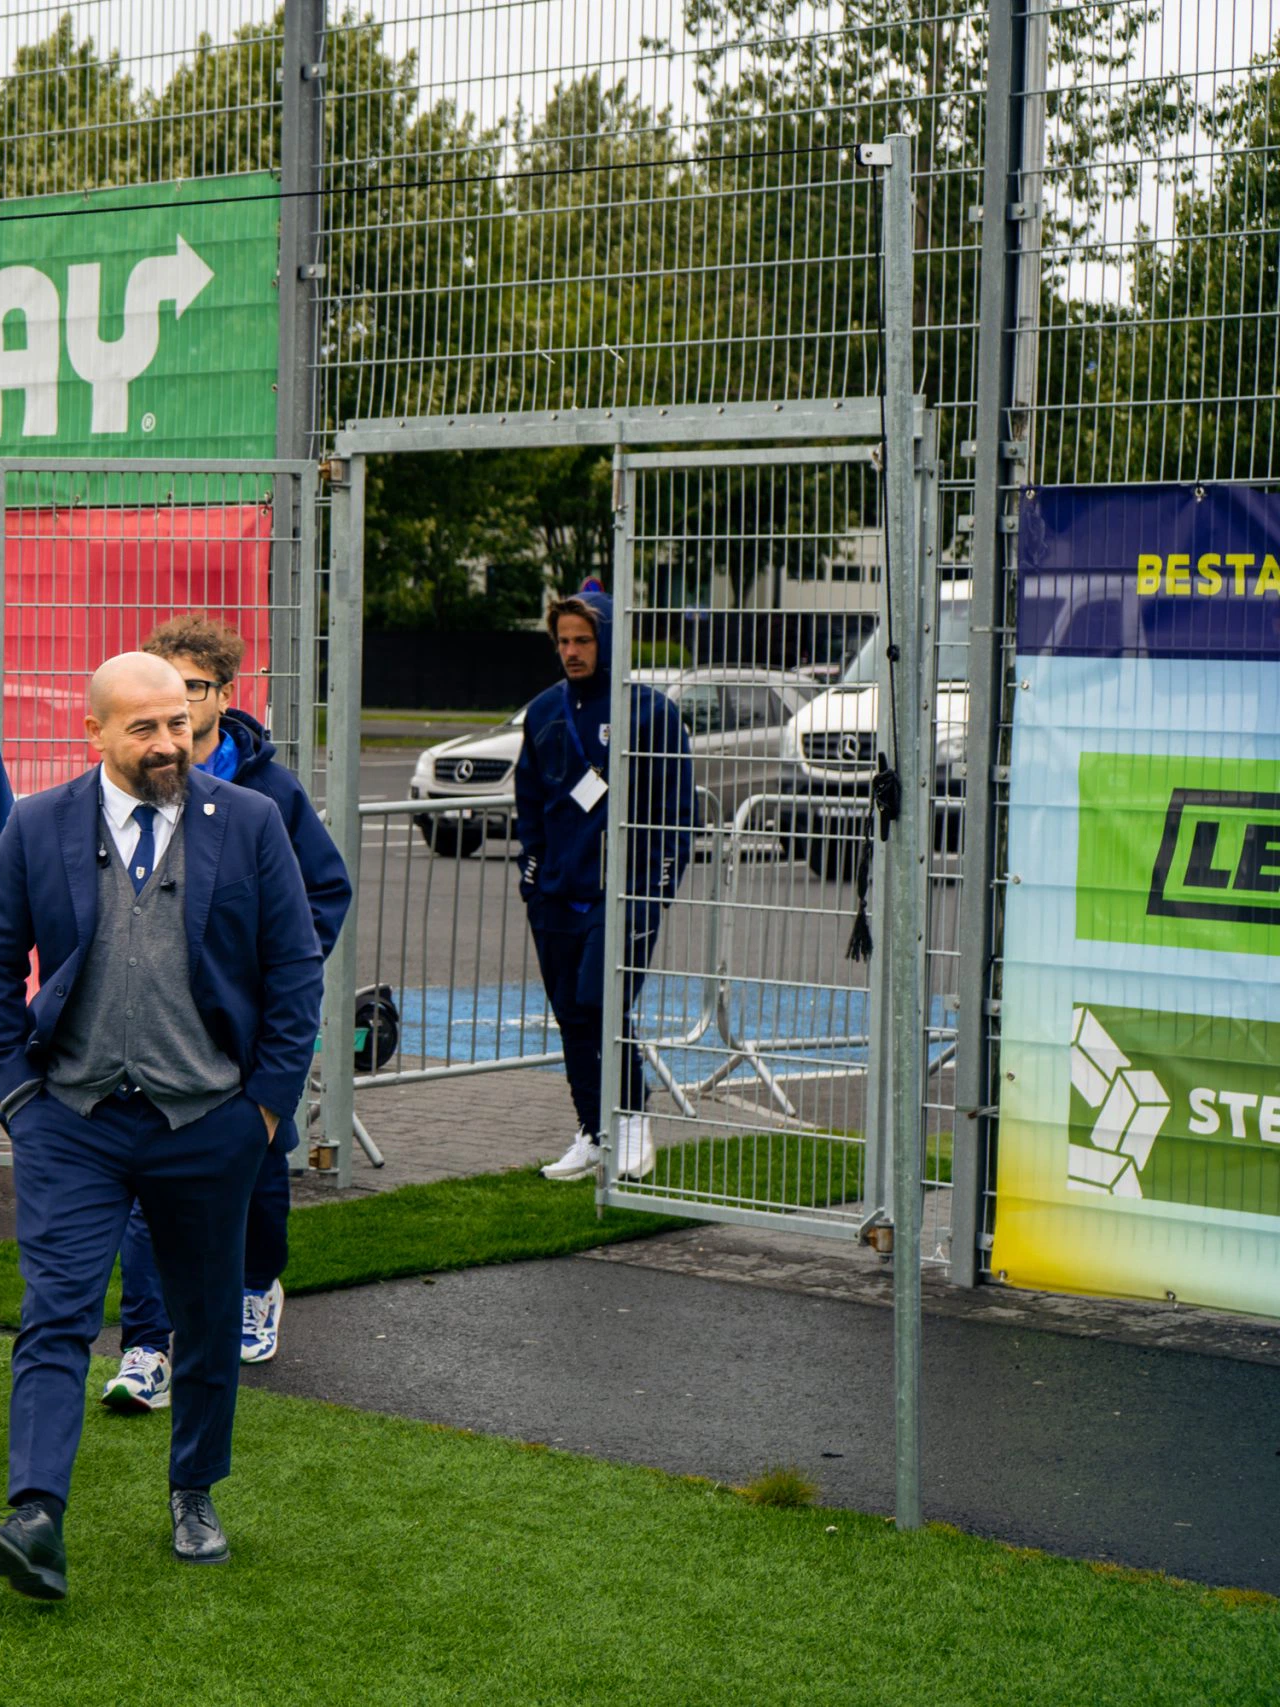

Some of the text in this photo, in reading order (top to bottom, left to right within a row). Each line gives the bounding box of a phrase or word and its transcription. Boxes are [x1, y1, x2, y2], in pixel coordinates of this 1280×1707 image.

[1136, 552, 1280, 596] BESTA
[1183, 821, 1280, 892] LE
[1189, 1087, 1280, 1144] STE
